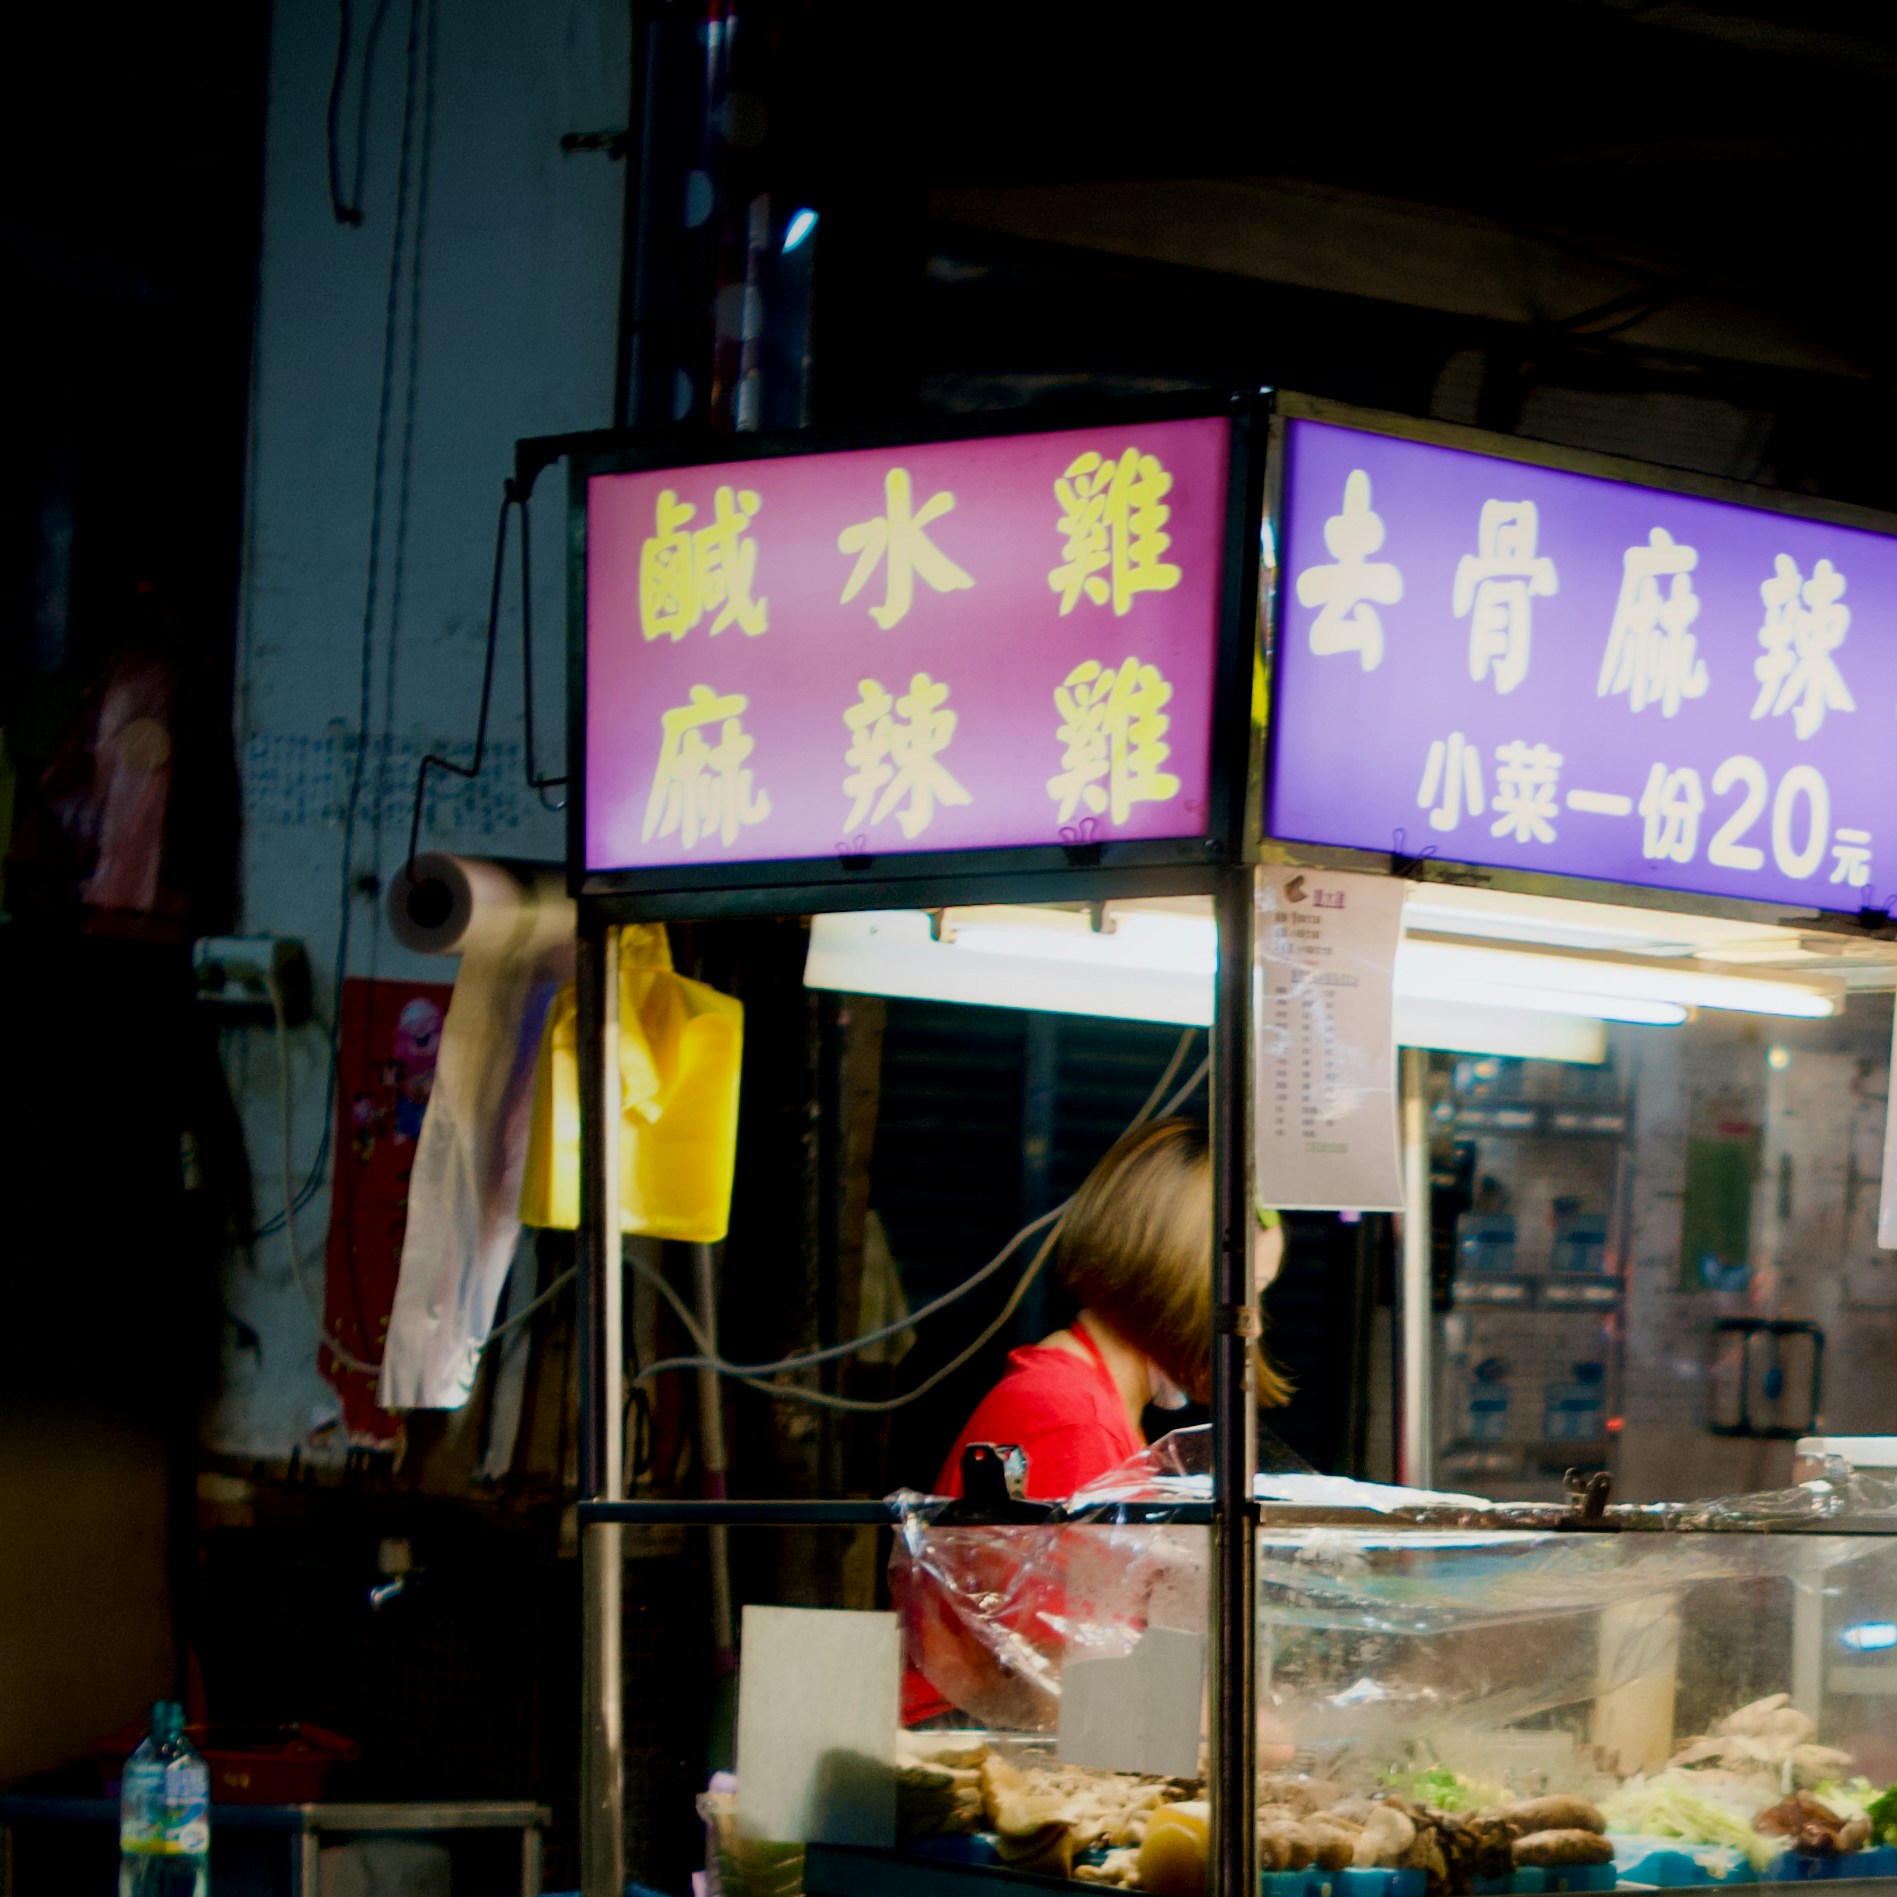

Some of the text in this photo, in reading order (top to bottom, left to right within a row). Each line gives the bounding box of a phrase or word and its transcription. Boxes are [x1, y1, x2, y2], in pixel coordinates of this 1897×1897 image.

[639, 447, 1181, 642] 鹹水雞
[640, 656, 1181, 850] 麻辣雞
[1417, 731, 1873, 888] 小菜一份20元
